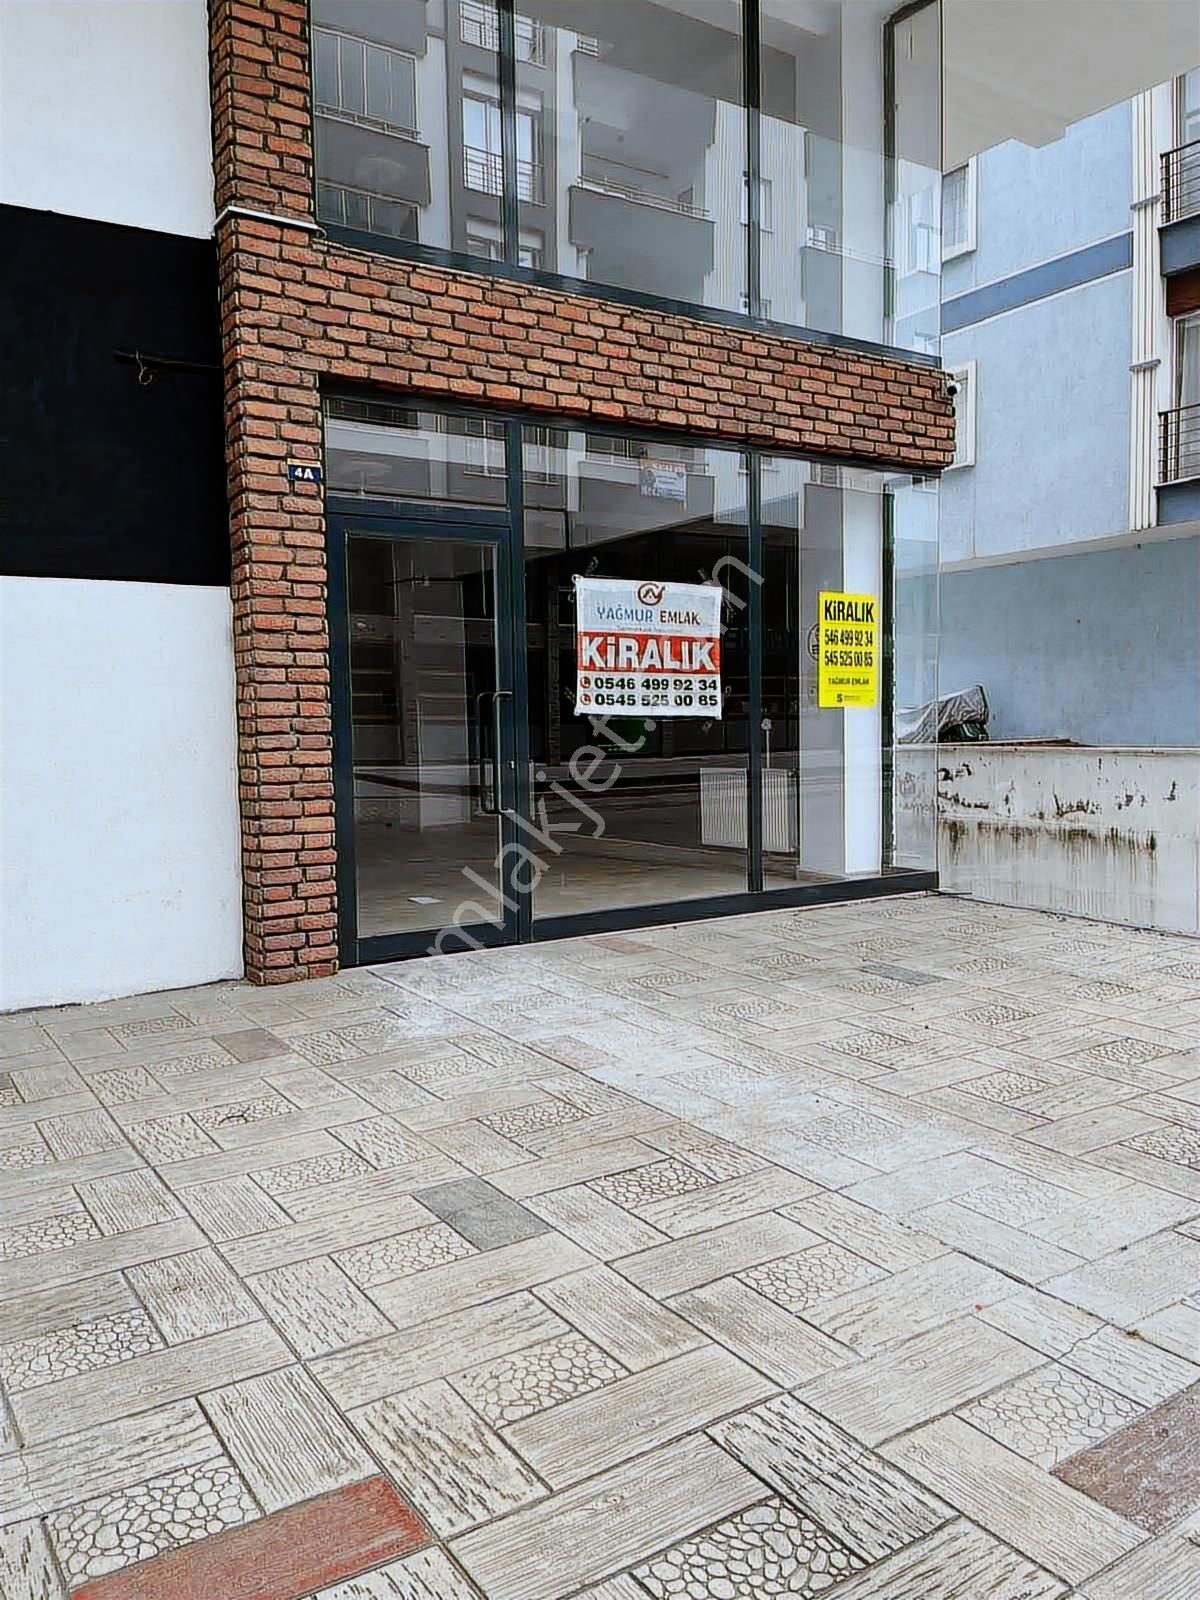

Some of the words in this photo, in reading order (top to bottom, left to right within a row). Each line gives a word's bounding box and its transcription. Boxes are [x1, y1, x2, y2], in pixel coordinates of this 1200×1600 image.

[294, 467, 314, 480] 4A
[597, 604, 654, 622] YAĞMUR
[660, 609, 701, 626] EMLAK
[825, 629, 839, 645] 546
[865, 631, 873, 647] 34
[825, 650, 839, 666] 545
[594, 677, 635, 690] 0546
[641, 678, 669, 691] 499
[673, 679, 693, 691] 92
[698, 679, 718, 691] 34
[595, 694, 636, 706] 0545
[641, 694, 669, 706] 525
[674, 694, 693, 706] 00
[699, 694, 718, 706] 85
